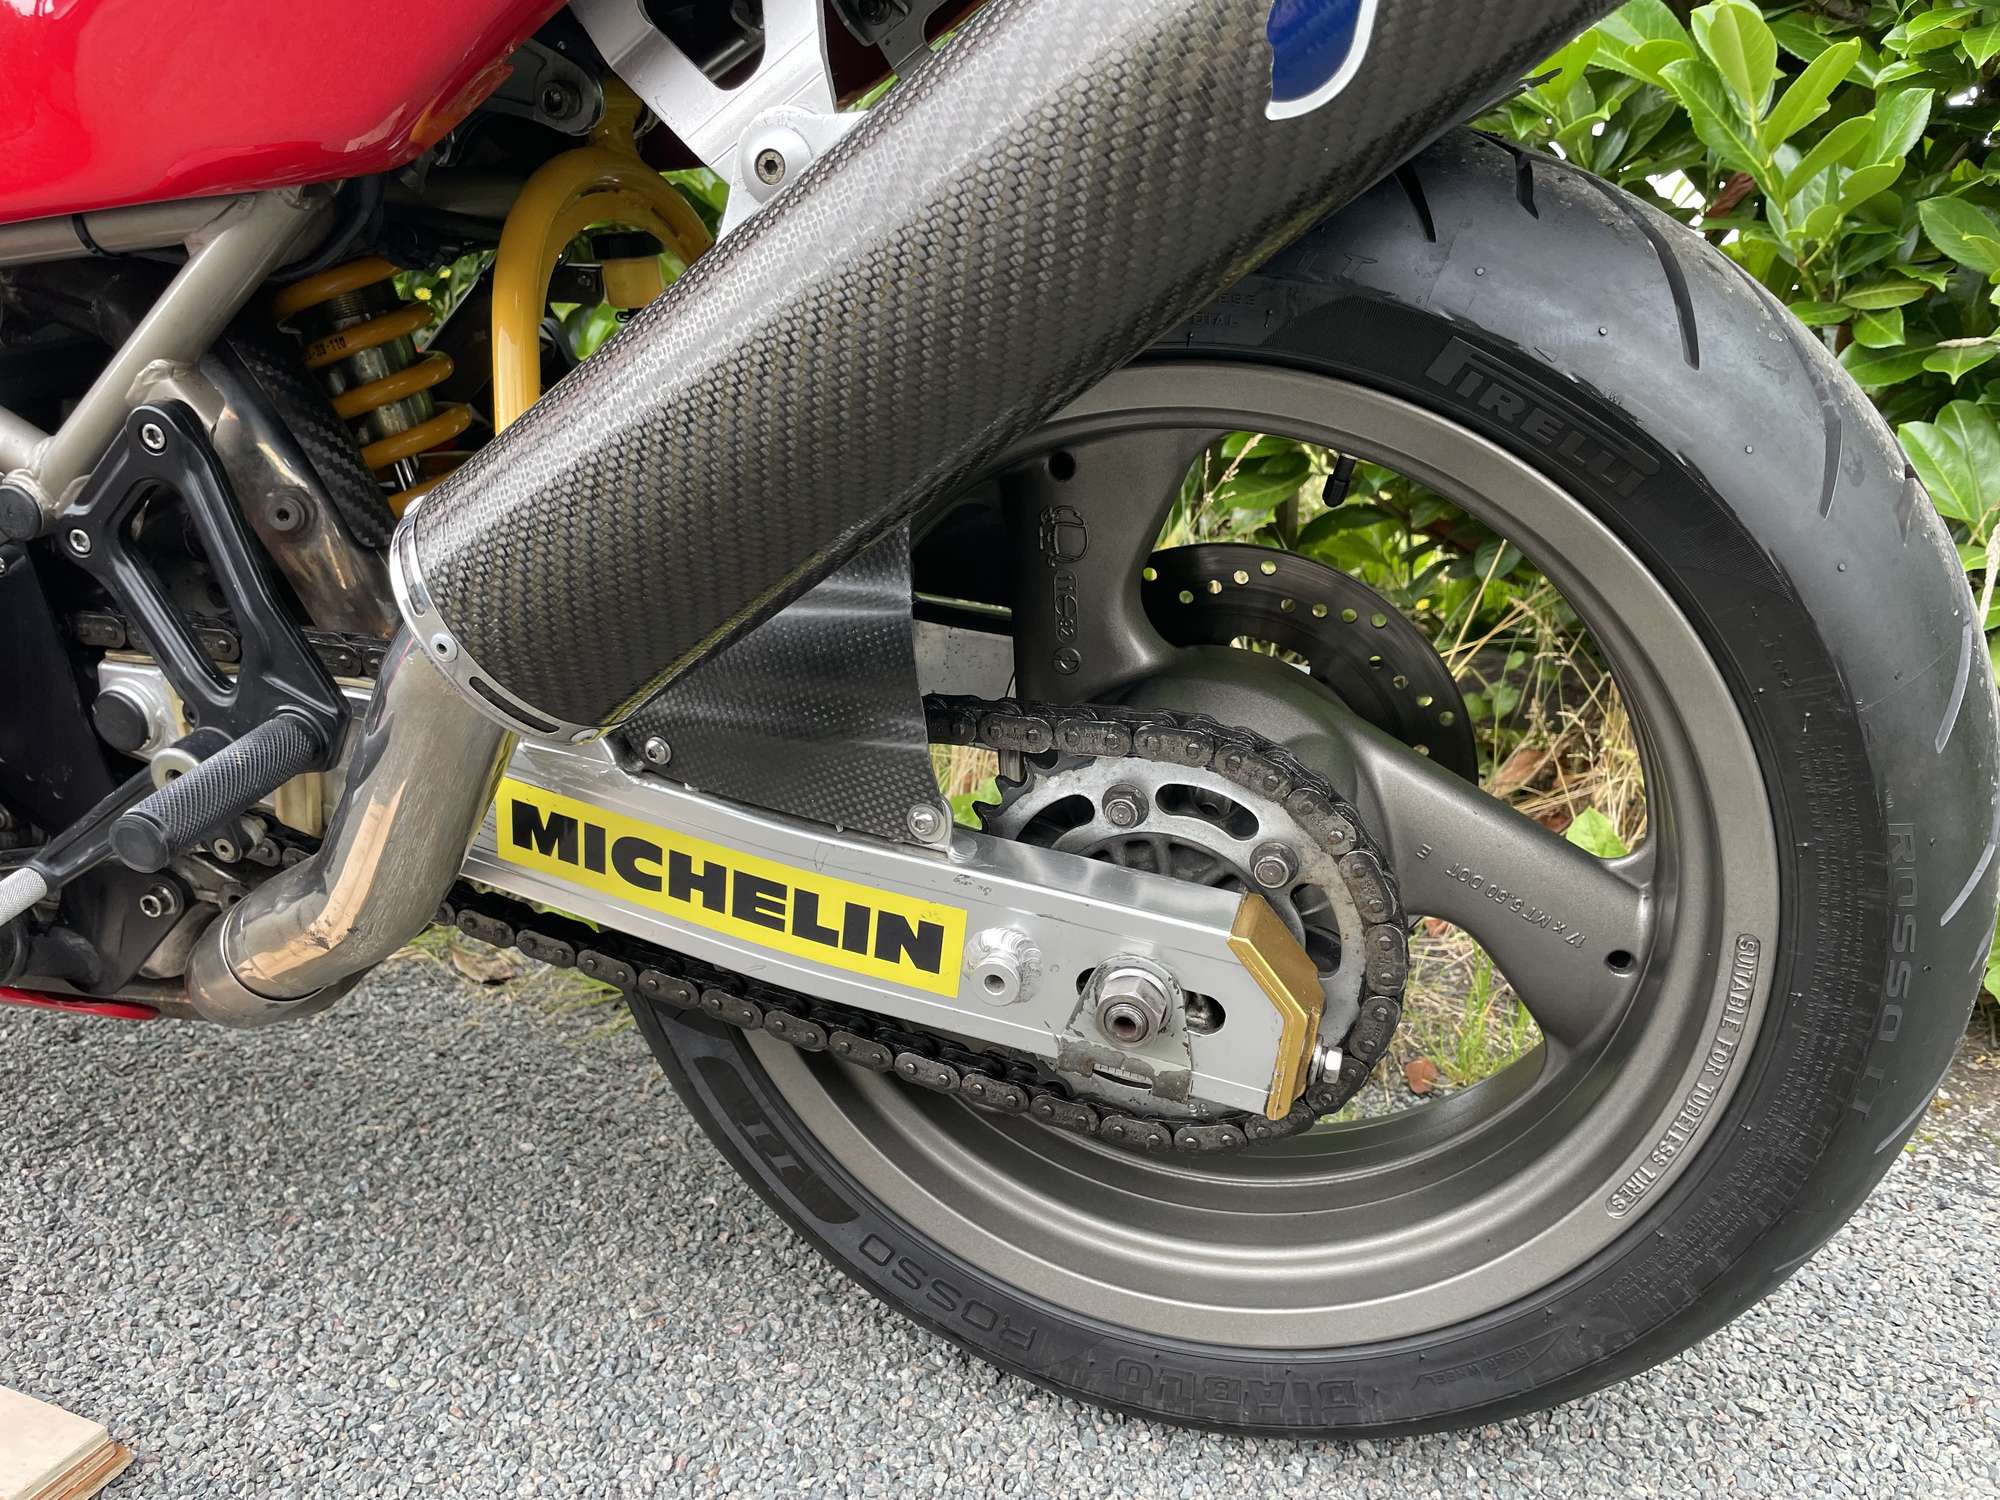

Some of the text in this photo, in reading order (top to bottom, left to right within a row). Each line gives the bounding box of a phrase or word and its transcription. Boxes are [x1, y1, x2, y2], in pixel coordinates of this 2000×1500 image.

[1425, 336, 1660, 497] PIRELLI
[511, 799, 944, 974] MICHELIN
[1445, 862, 1485, 890] DOT
[1486, 884, 1525, 913] 5.50
[1522, 906, 1553, 929] MT
[1566, 932, 1587, 949] 17
[1879, 823, 1918, 1042] ROSSO
[1610, 935, 1758, 1211] SUITABLE FOR TUBELESS TIRES
[858, 1233, 1038, 1352] ROSSO
[1113, 1357, 1359, 1410] DIABLO
